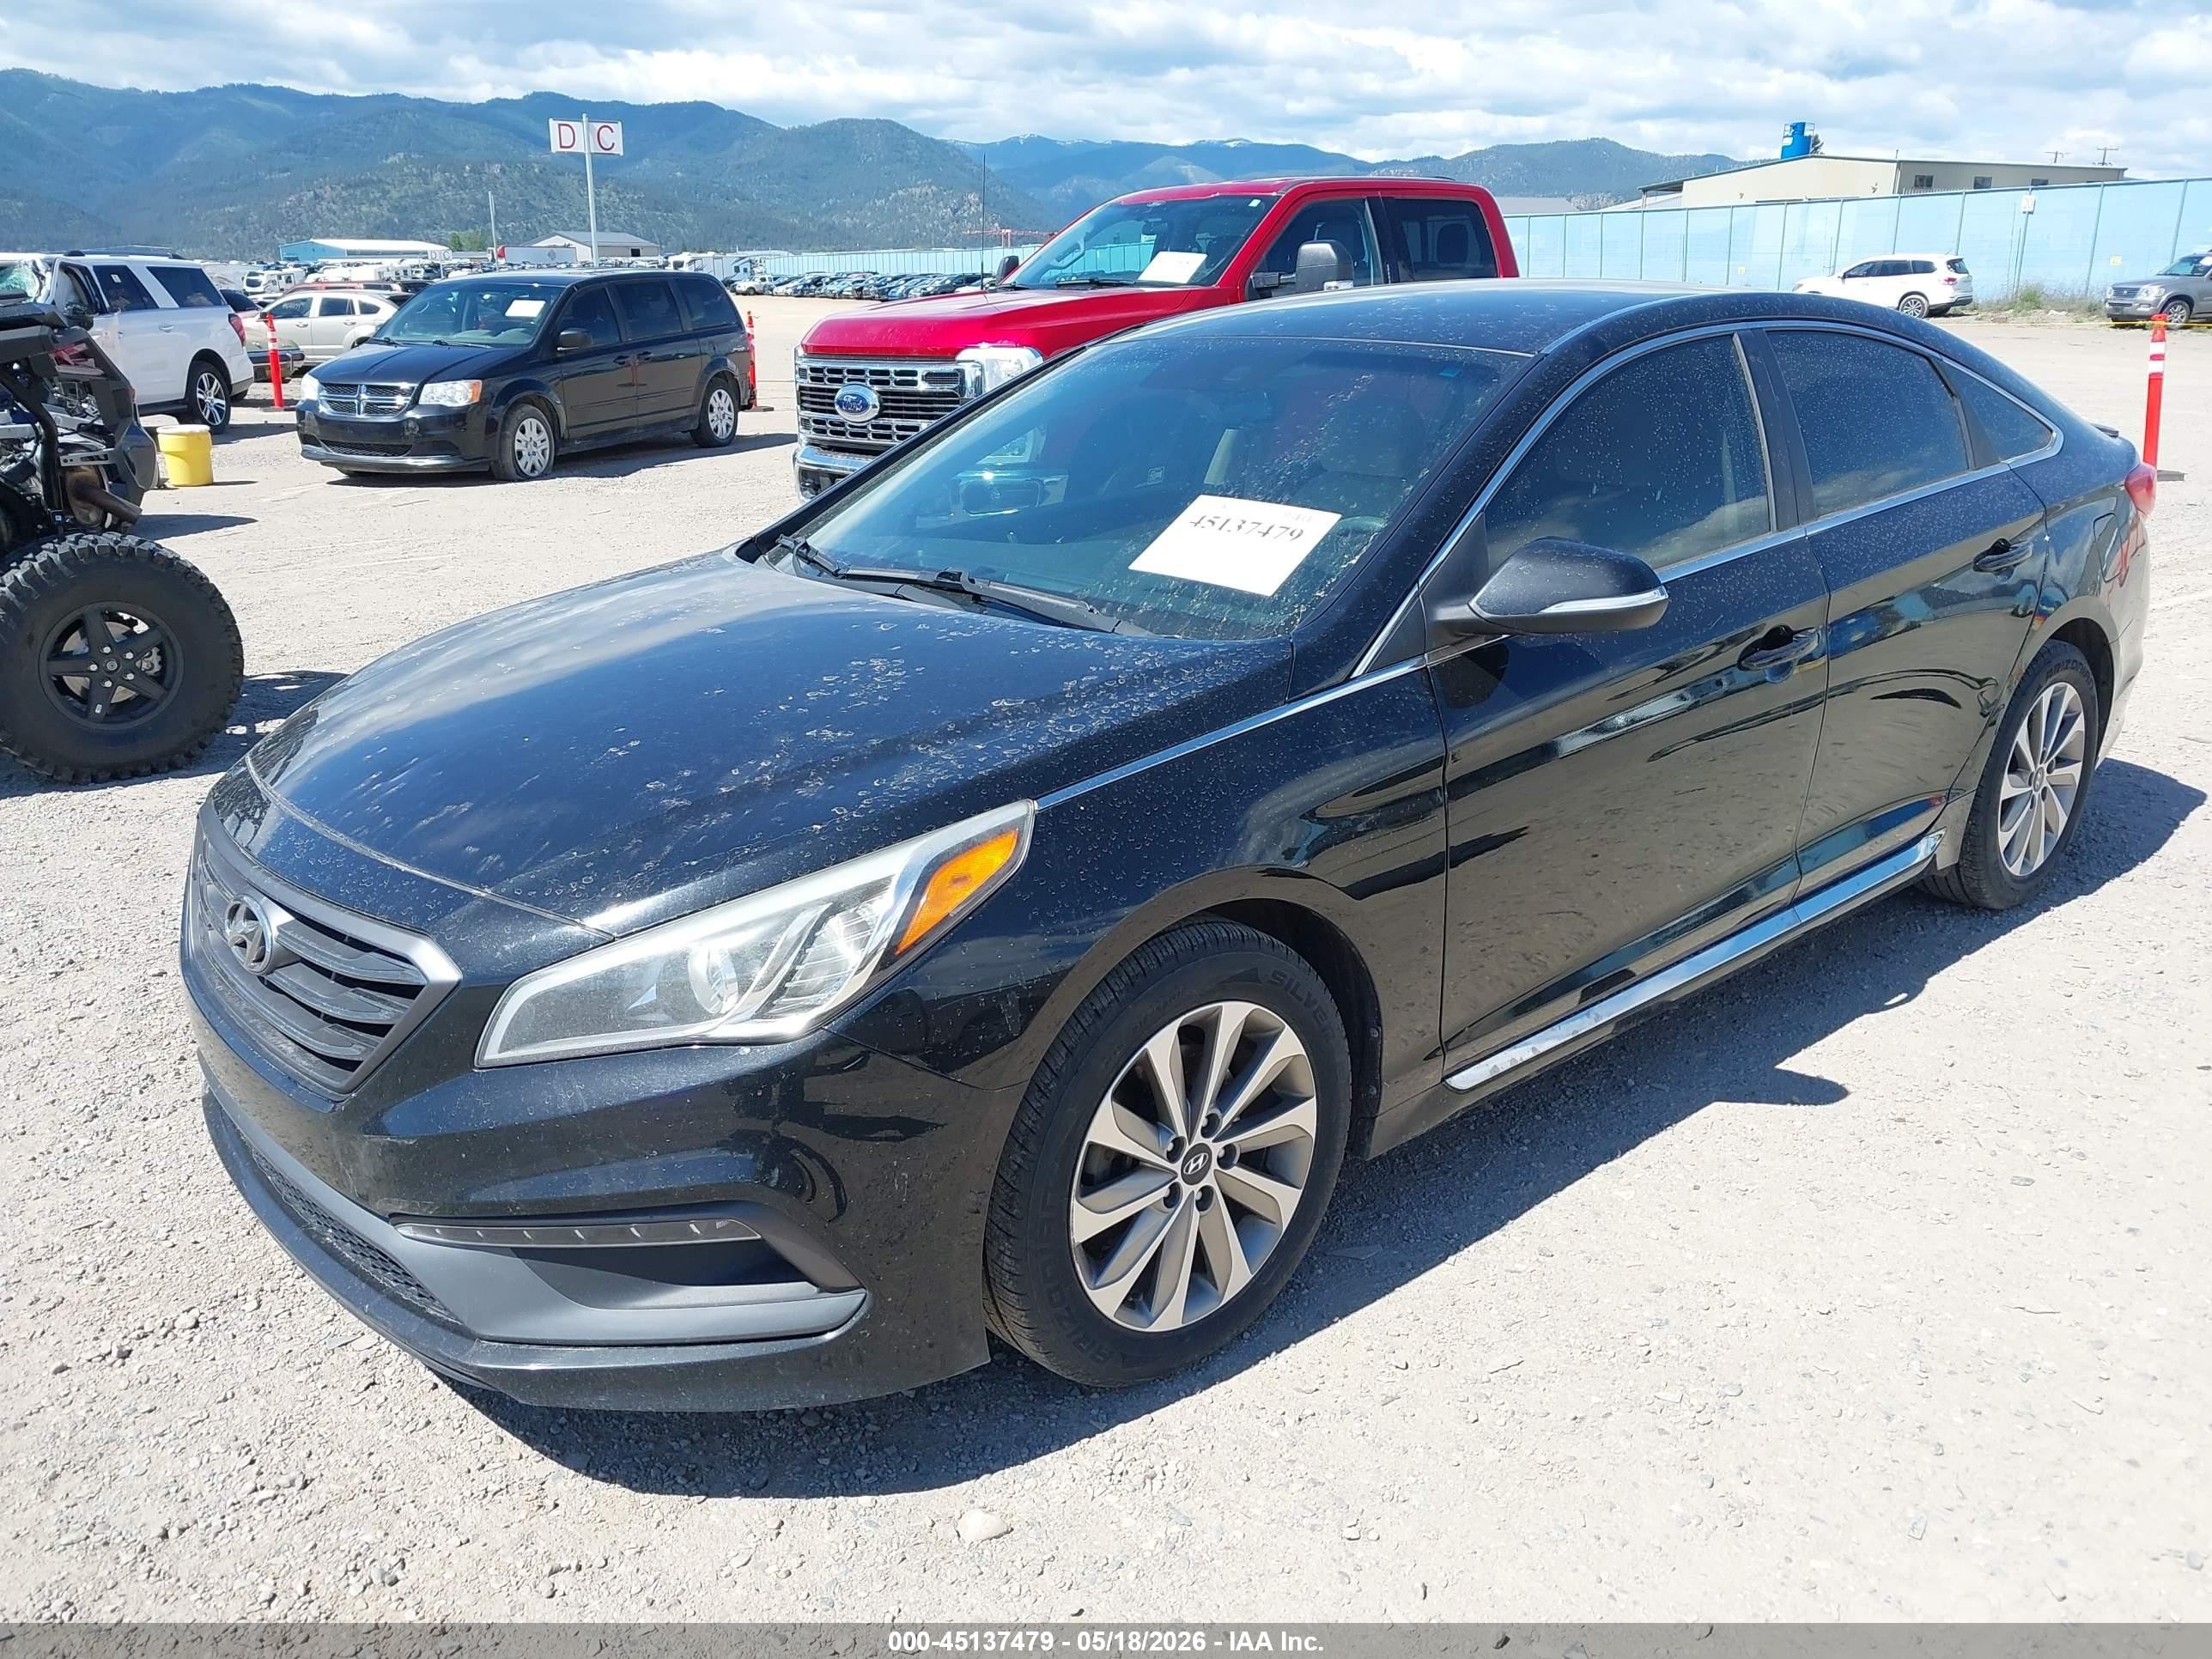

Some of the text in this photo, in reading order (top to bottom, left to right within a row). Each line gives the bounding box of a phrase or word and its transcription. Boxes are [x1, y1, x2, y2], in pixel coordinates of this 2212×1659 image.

[557, 123, 615, 151] D C
[842, 394, 864, 411] Ford
[1189, 514, 1304, 542] 45137479
[1267, 969, 1334, 1042] SILVER
